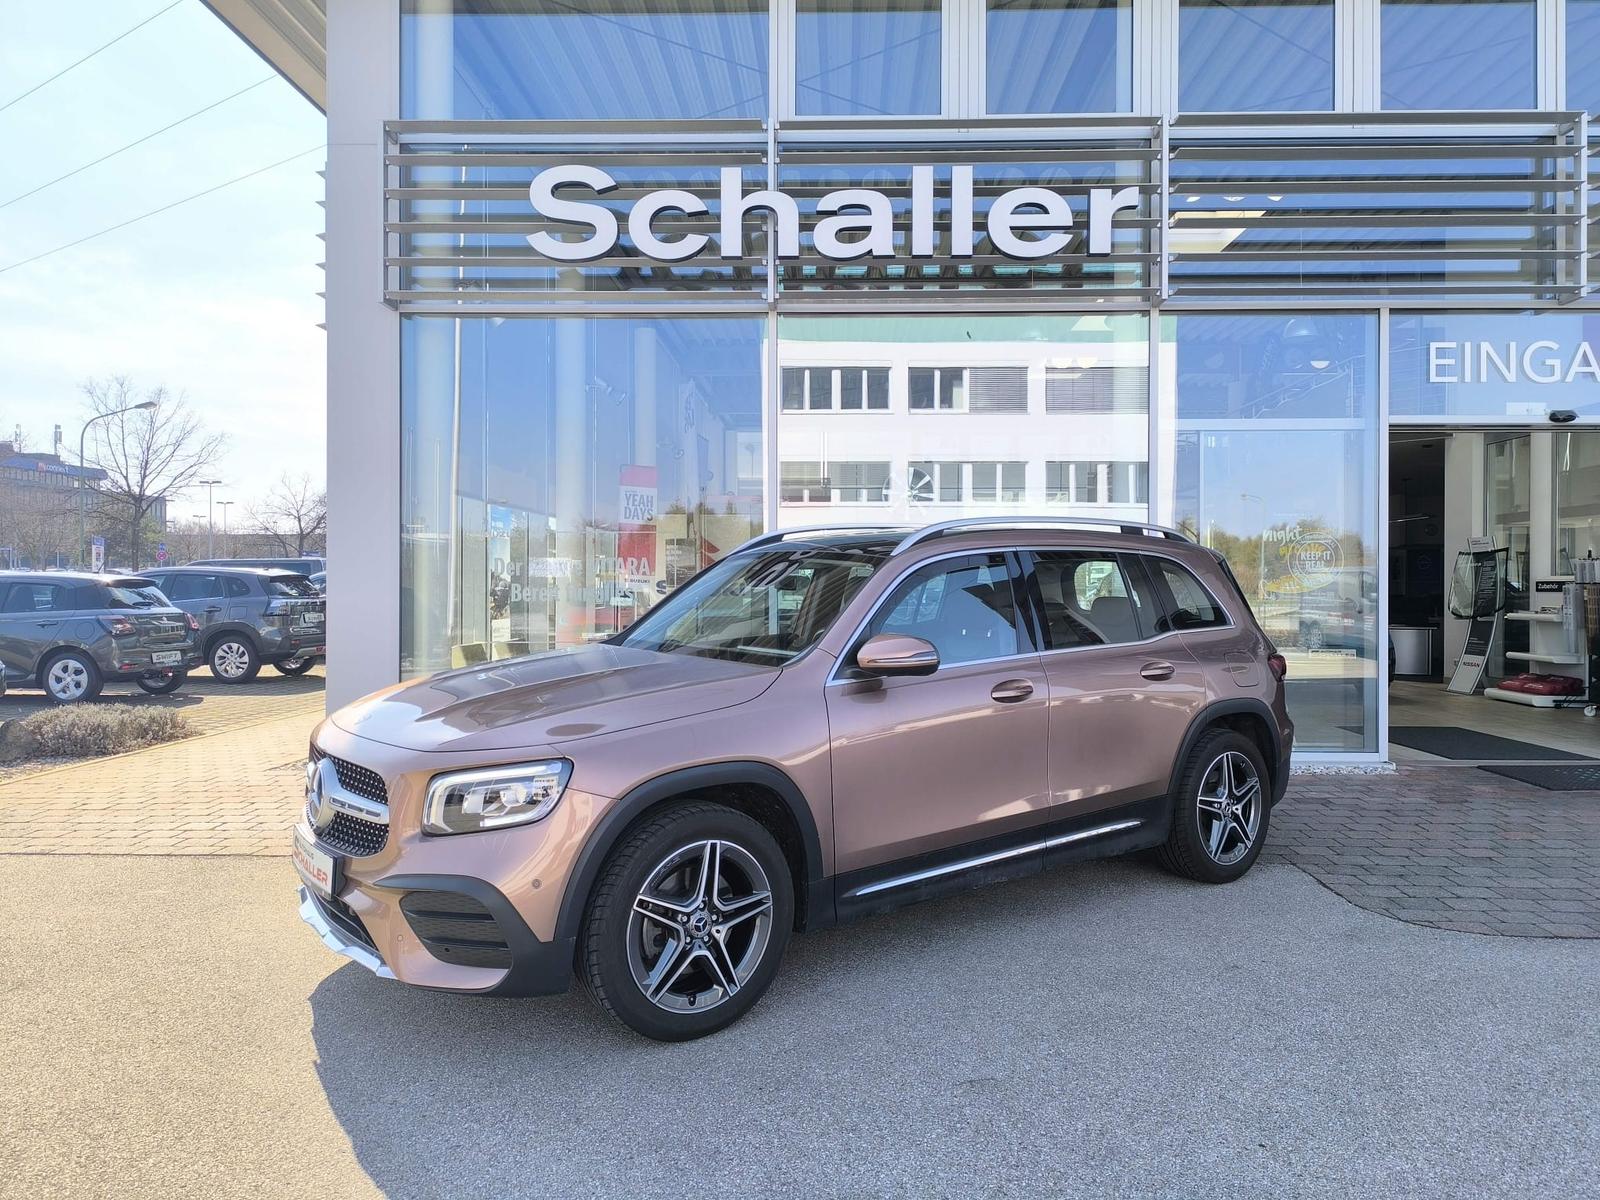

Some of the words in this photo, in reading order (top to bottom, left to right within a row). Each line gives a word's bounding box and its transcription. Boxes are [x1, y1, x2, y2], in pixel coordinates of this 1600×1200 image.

[525, 164, 1140, 262] Schaller
[1429, 340, 1600, 384] EINGA
[624, 493, 654, 508] YEAH
[624, 506, 654, 522] DAYS
[1300, 551, 1321, 561] KEEP
[1323, 550, 1331, 560] IT
[494, 557, 523, 577] Der
